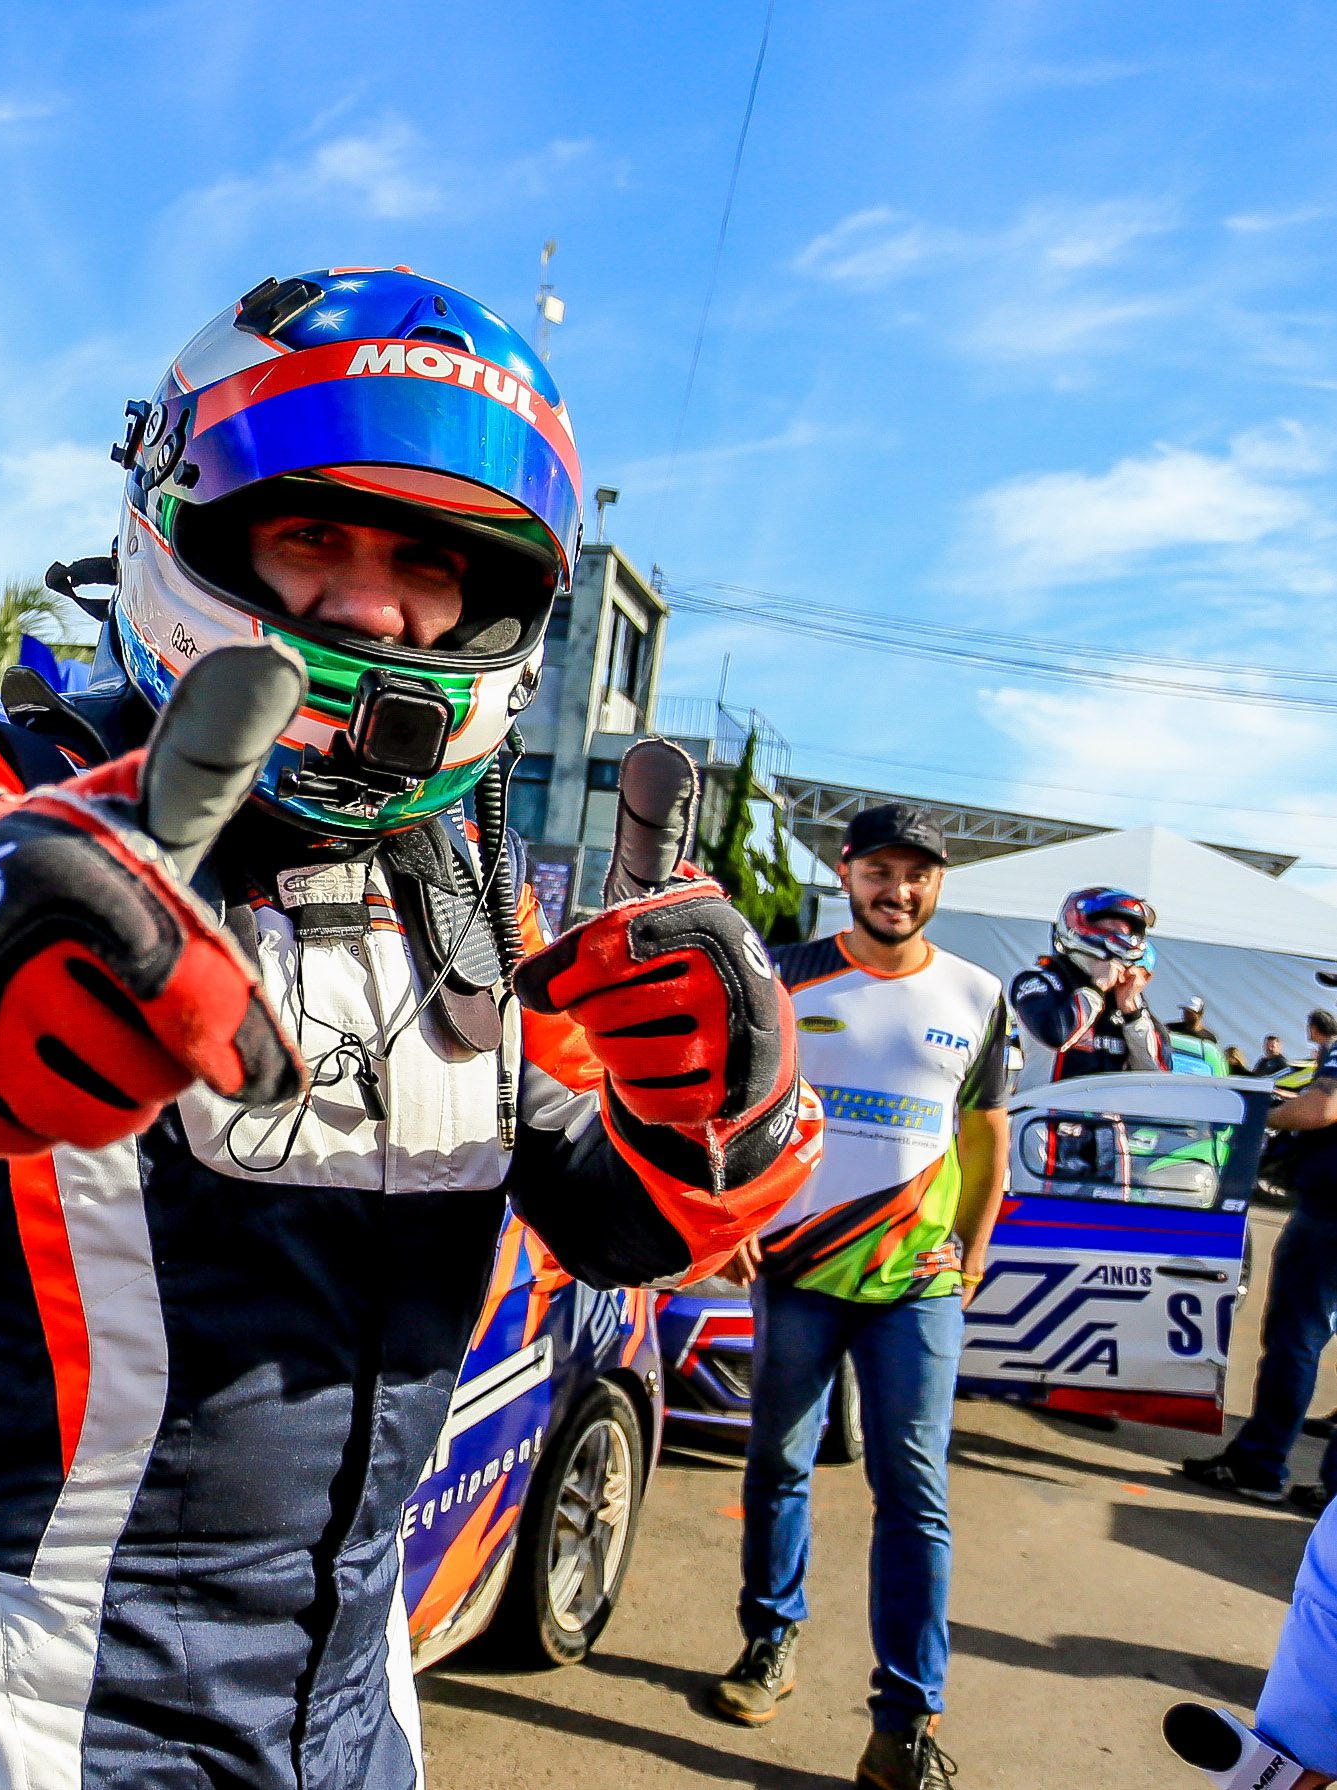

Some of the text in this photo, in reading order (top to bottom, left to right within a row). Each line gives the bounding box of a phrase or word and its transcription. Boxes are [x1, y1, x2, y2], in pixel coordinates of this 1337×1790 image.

[346, 344, 538, 425] MOTUL
[1082, 1265, 1152, 1286] ANOS
[401, 1425, 545, 1541] Equipment
